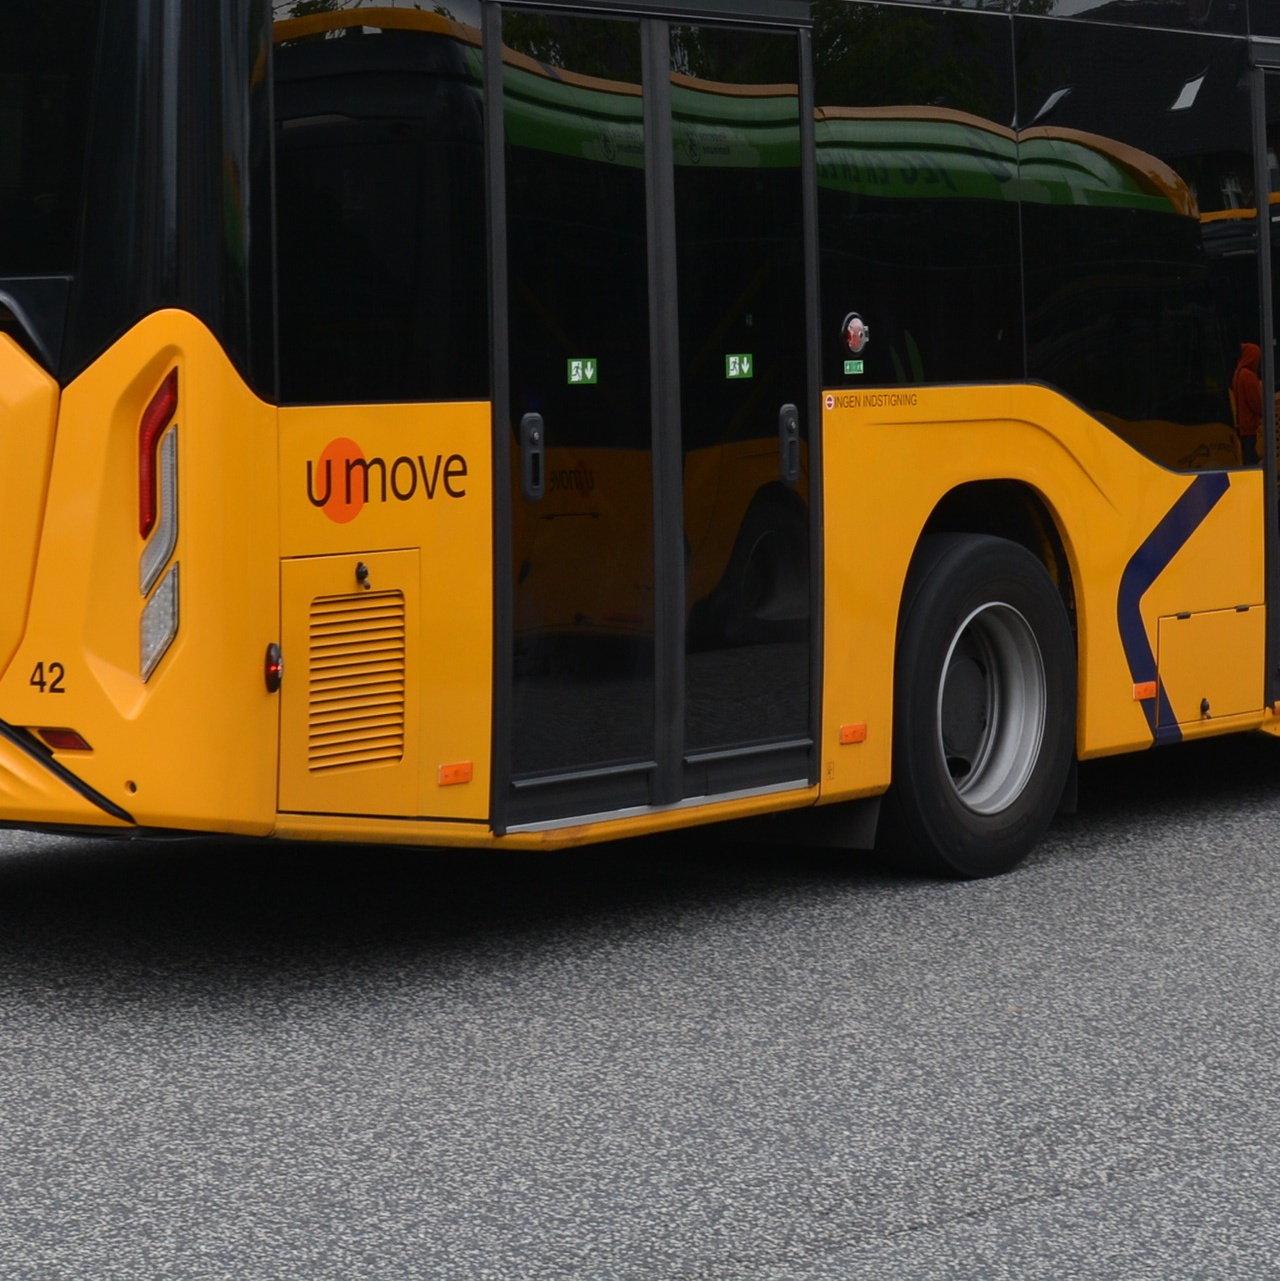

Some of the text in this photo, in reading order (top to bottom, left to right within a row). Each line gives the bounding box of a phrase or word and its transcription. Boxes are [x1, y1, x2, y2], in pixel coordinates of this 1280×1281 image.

[834, 394, 918, 409] INGEN INDSTIGNING
[30, 662, 65, 693] 42
